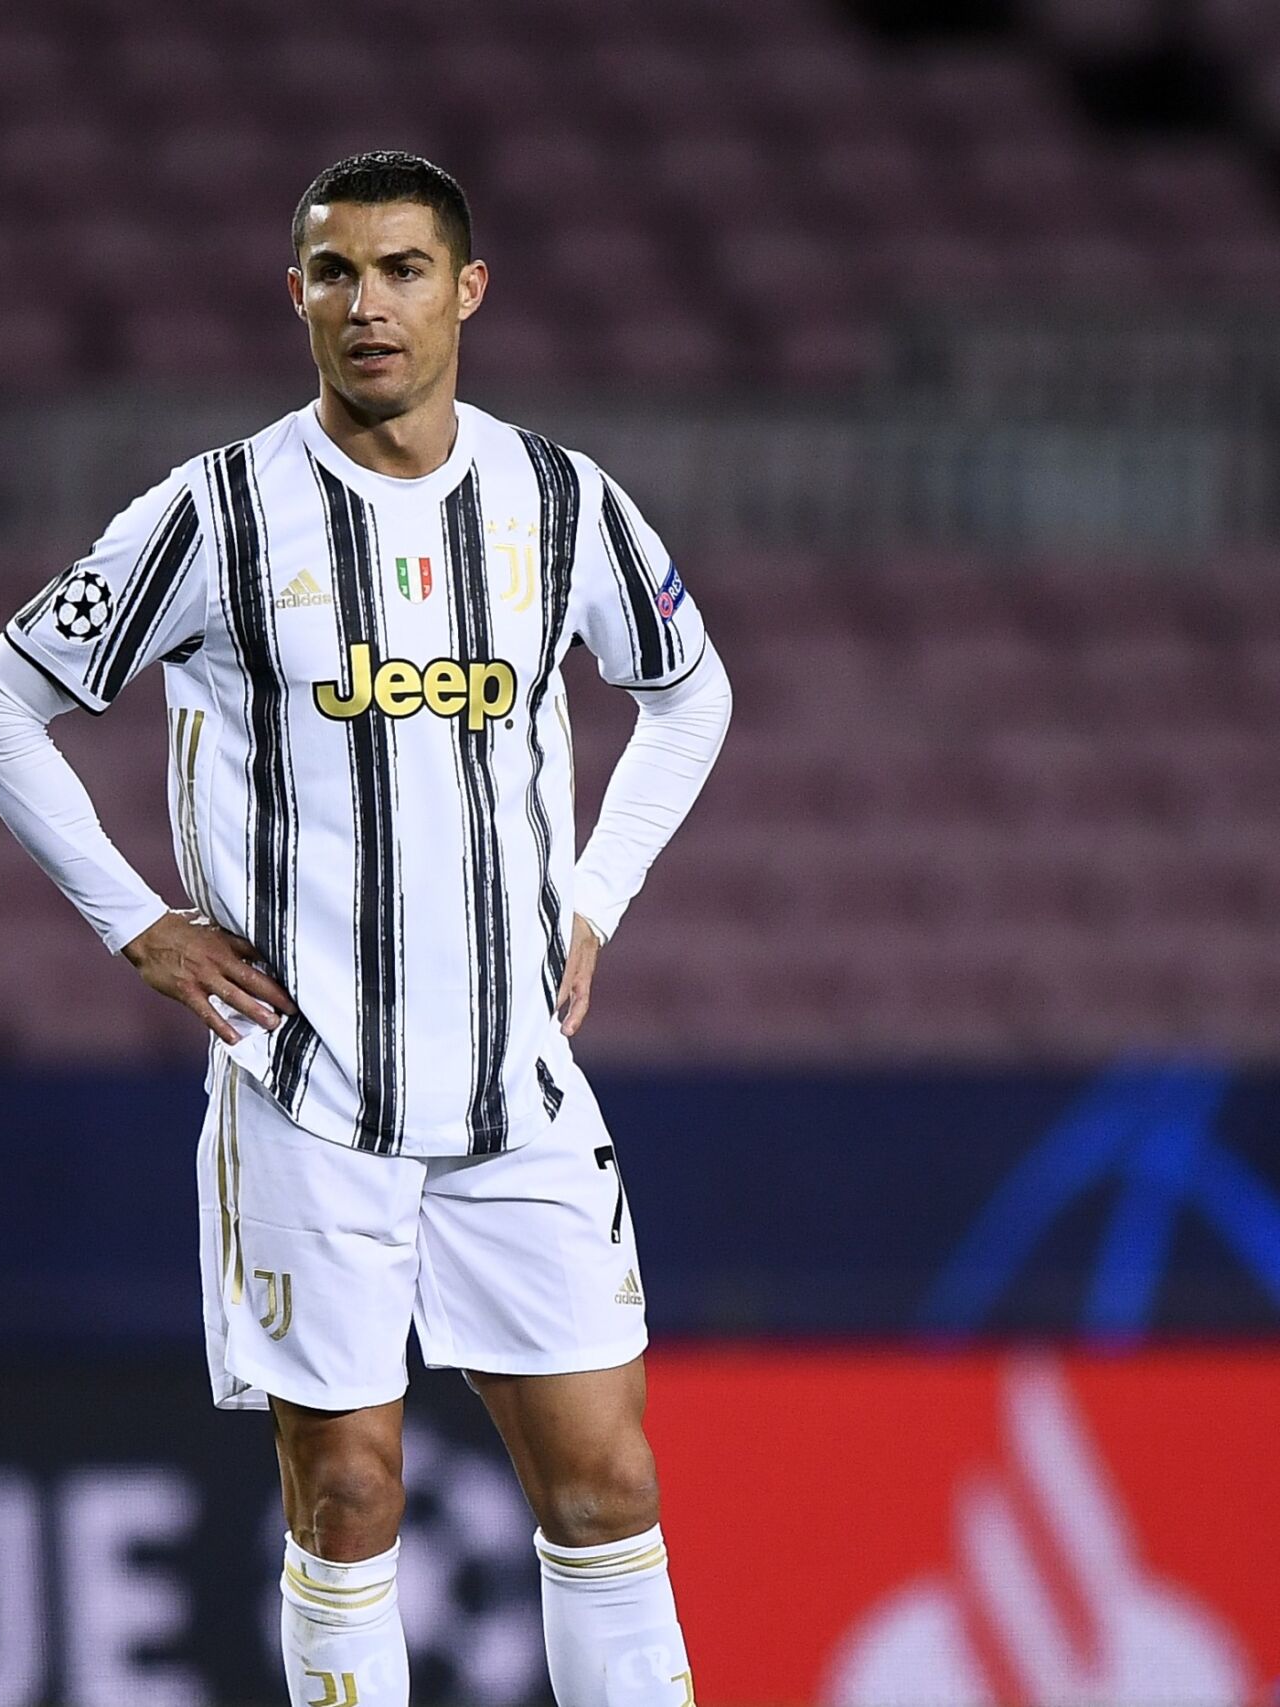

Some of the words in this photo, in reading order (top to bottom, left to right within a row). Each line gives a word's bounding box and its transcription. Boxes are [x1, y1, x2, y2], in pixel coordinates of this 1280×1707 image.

[276, 593, 332, 609] adidas
[312, 642, 517, 732] Jeep
[593, 1144, 624, 1244] 7
